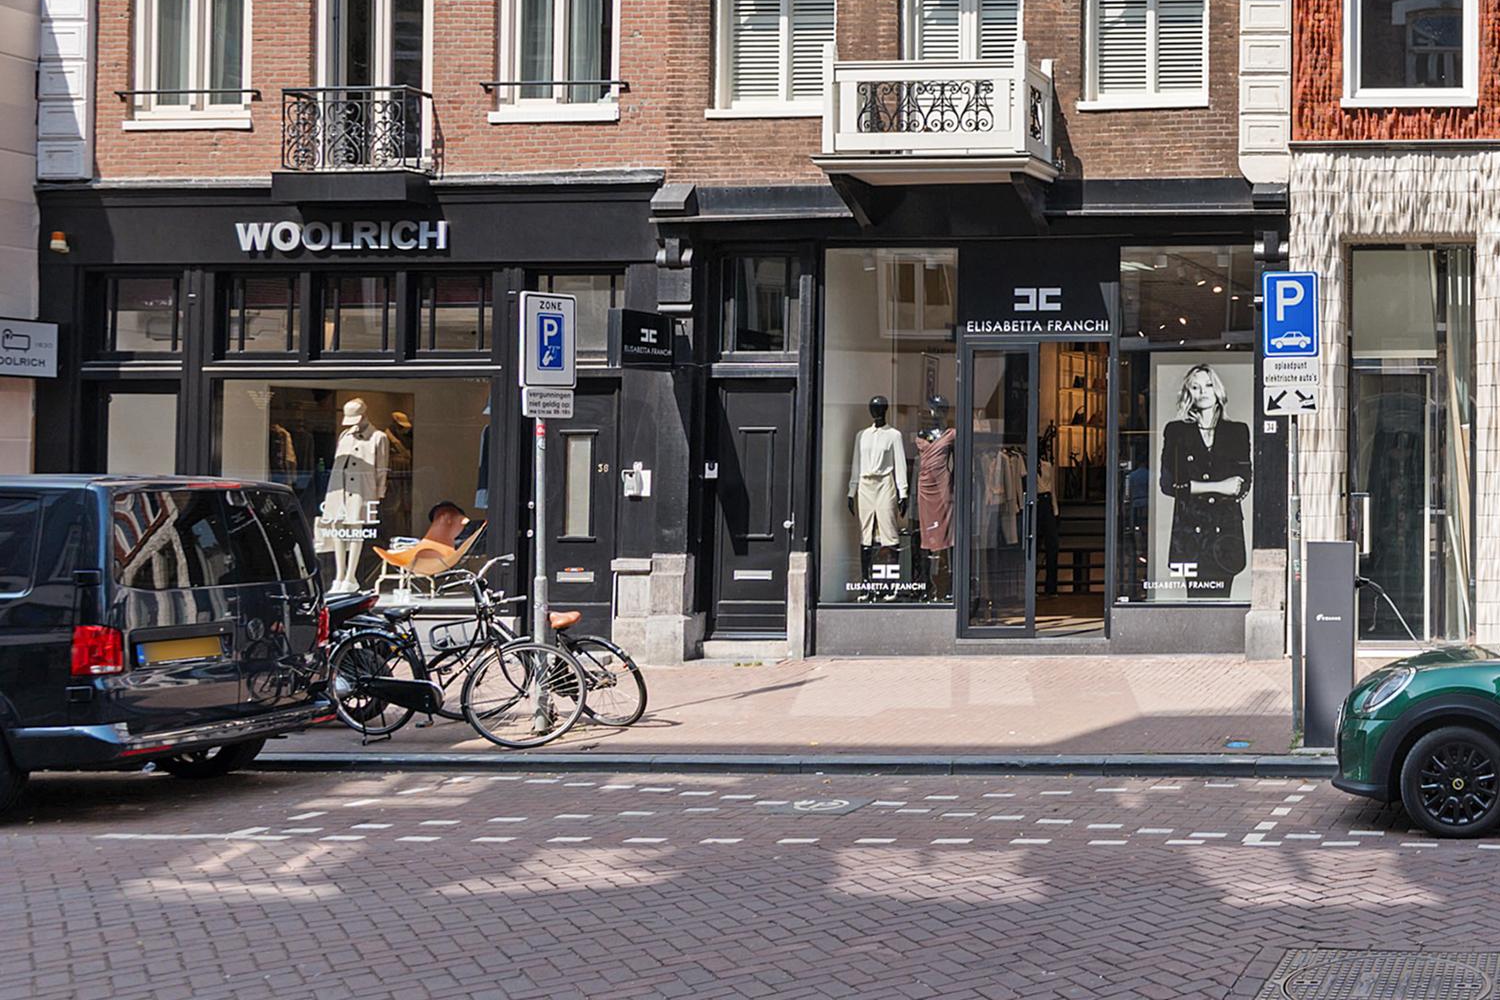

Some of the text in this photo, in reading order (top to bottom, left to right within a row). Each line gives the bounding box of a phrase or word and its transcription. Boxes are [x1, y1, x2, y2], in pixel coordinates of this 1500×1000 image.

[235, 221, 448, 251] WOOLRICH
[1276, 280, 1304, 321] P
[540, 301, 562, 310] ZONE
[966, 320, 1109, 332] ELISABETTA FRANCHI
[543, 319, 558, 346] P
[1275, 362, 1307, 370] oplaadpunt
[1265, 373, 1317, 382] elektrische auto's
[529, 392, 571, 400] vergunningen
[320, 501, 380, 524] SALE
[320, 529, 377, 538] WOOLRICH
[1143, 581, 1224, 589] ELISABETTA FRANCHI
